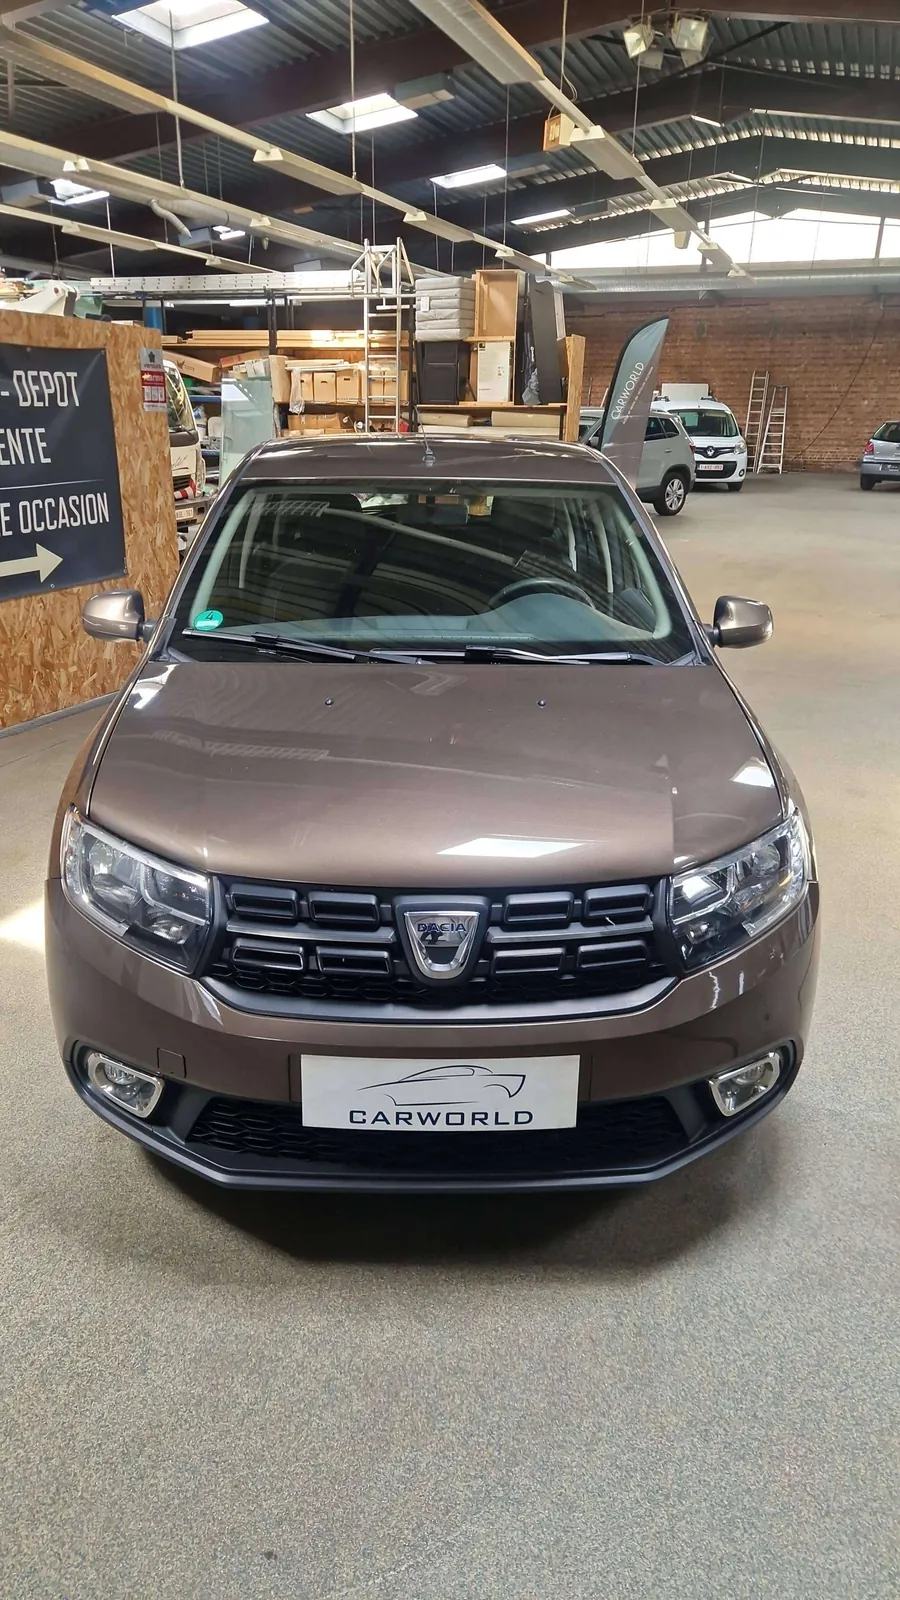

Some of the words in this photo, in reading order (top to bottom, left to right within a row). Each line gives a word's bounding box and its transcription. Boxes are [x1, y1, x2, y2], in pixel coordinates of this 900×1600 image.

[13, 370, 80, 407] DEPOT
[611, 362, 644, 420] CARWORLD
[0, 502, 13, 536] E
[19, 492, 109, 534] OCCASION
[205, 611, 214, 621] 4
[417, 923, 467, 932] DACIA
[349, 1110, 534, 1126] CARWORLD
